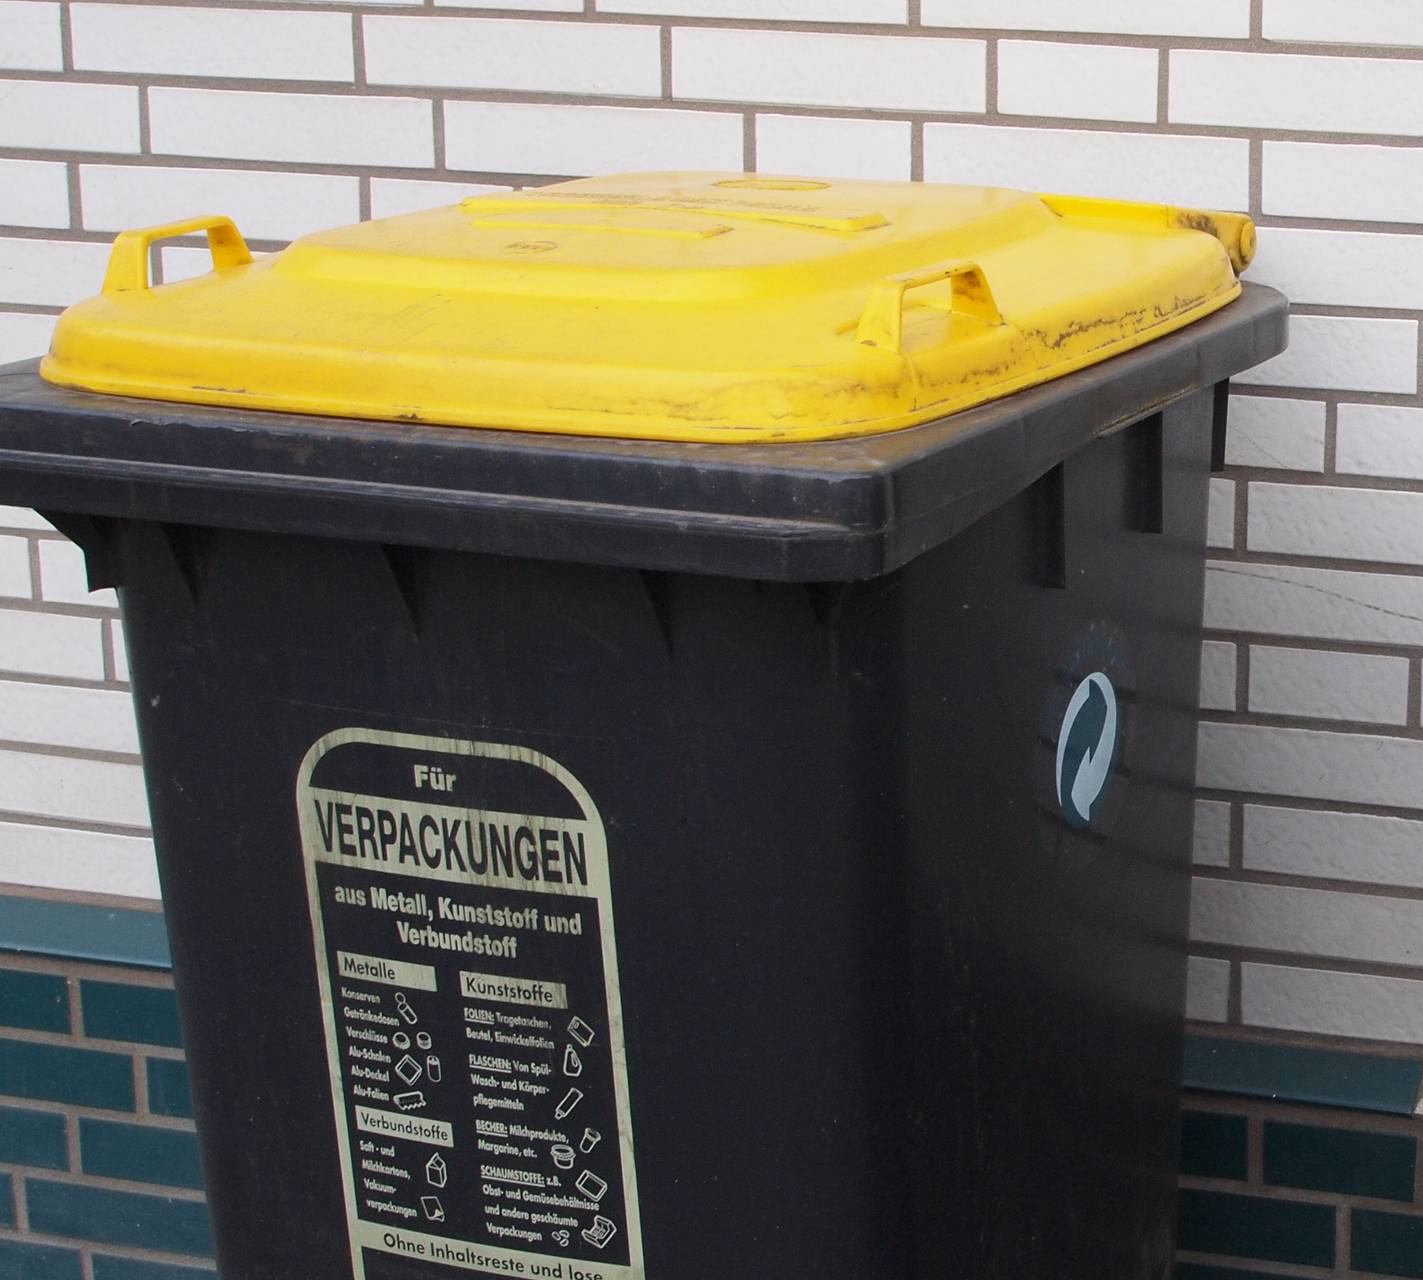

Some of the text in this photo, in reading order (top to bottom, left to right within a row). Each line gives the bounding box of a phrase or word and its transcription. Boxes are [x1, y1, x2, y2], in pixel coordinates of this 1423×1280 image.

[413, 765, 456, 792] Für
[314, 799, 588, 886] VERPACKUNGEN
[335, 884, 582, 935] aus Metall, Kunststoff und
[396, 921, 517, 958] Verbundstoff
[344, 958, 395, 980] Metalle
[341, 987, 380, 1003] Konserven
[466, 978, 552, 1003] Kunststoffe
[344, 1006, 400, 1027] Getränkedosen
[464, 1008, 552, 1030] FOLIEN: Tragetaschen,
[346, 1026, 388, 1043] Verschlüsse
[466, 1028, 554, 1049] Beutel, Einwickelfolien
[349, 1046, 391, 1063] Alu-Schalen
[469, 1054, 551, 1076] FLASCHEN: Von Spül-
[352, 1065, 389, 1082] Alu-Deckel
[354, 1084, 389, 1100] Alu-Folien
[471, 1074, 550, 1096] Wasch- und Körper-
[473, 1094, 524, 1110] pflegemitteln
[360, 1112, 448, 1141] Verbundstoffe
[476, 1120, 569, 1144] BECHER: Milchprodukte,
[381, 1146, 394, 1156] und
[478, 1140, 537, 1158] Margarine, etc.
[362, 1160, 410, 1180] Milchkartons,
[481, 1165, 545, 1184] SCHAUMSTOFFE:
[364, 1178, 396, 1194] Vakuum-
[366, 1199, 417, 1218] verpackungen
[482, 1185, 600, 1211] Obst- und Gemüsebehältnisse
[485, 1205, 578, 1227] und andere geschäumte
[486, 1223, 542, 1242] Verpackungen
[384, 1233, 603, 1280] Ohne Inhaltsreste und lose
